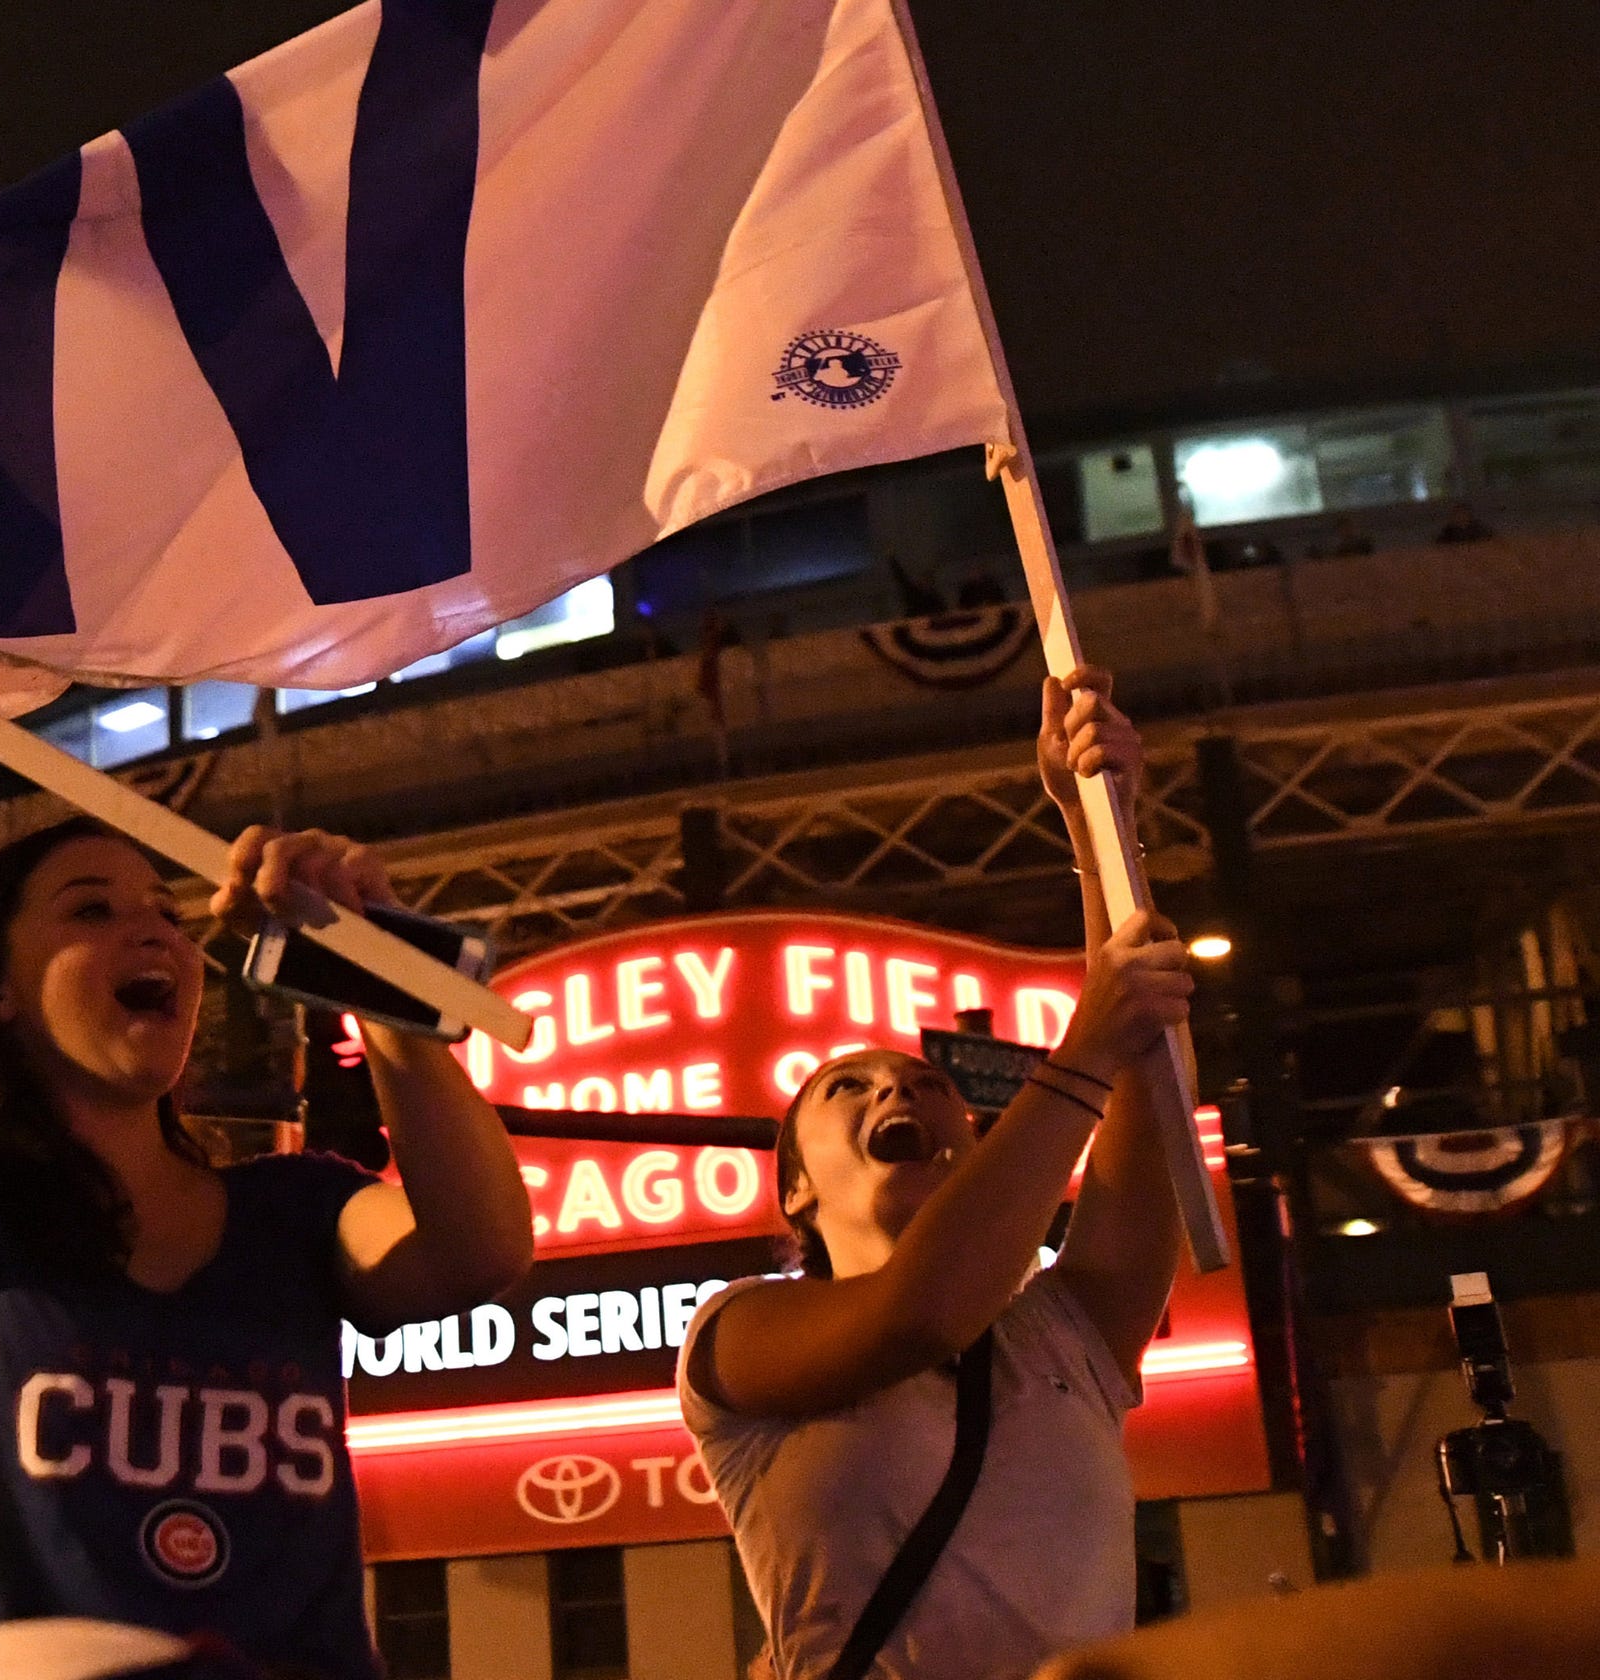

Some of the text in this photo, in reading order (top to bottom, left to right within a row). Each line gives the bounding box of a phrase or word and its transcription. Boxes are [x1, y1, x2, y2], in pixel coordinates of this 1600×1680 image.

[466, 948, 733, 1089] IGLEY
[774, 1043, 866, 1097] O
[16, 1372, 334, 1498] CUBS
